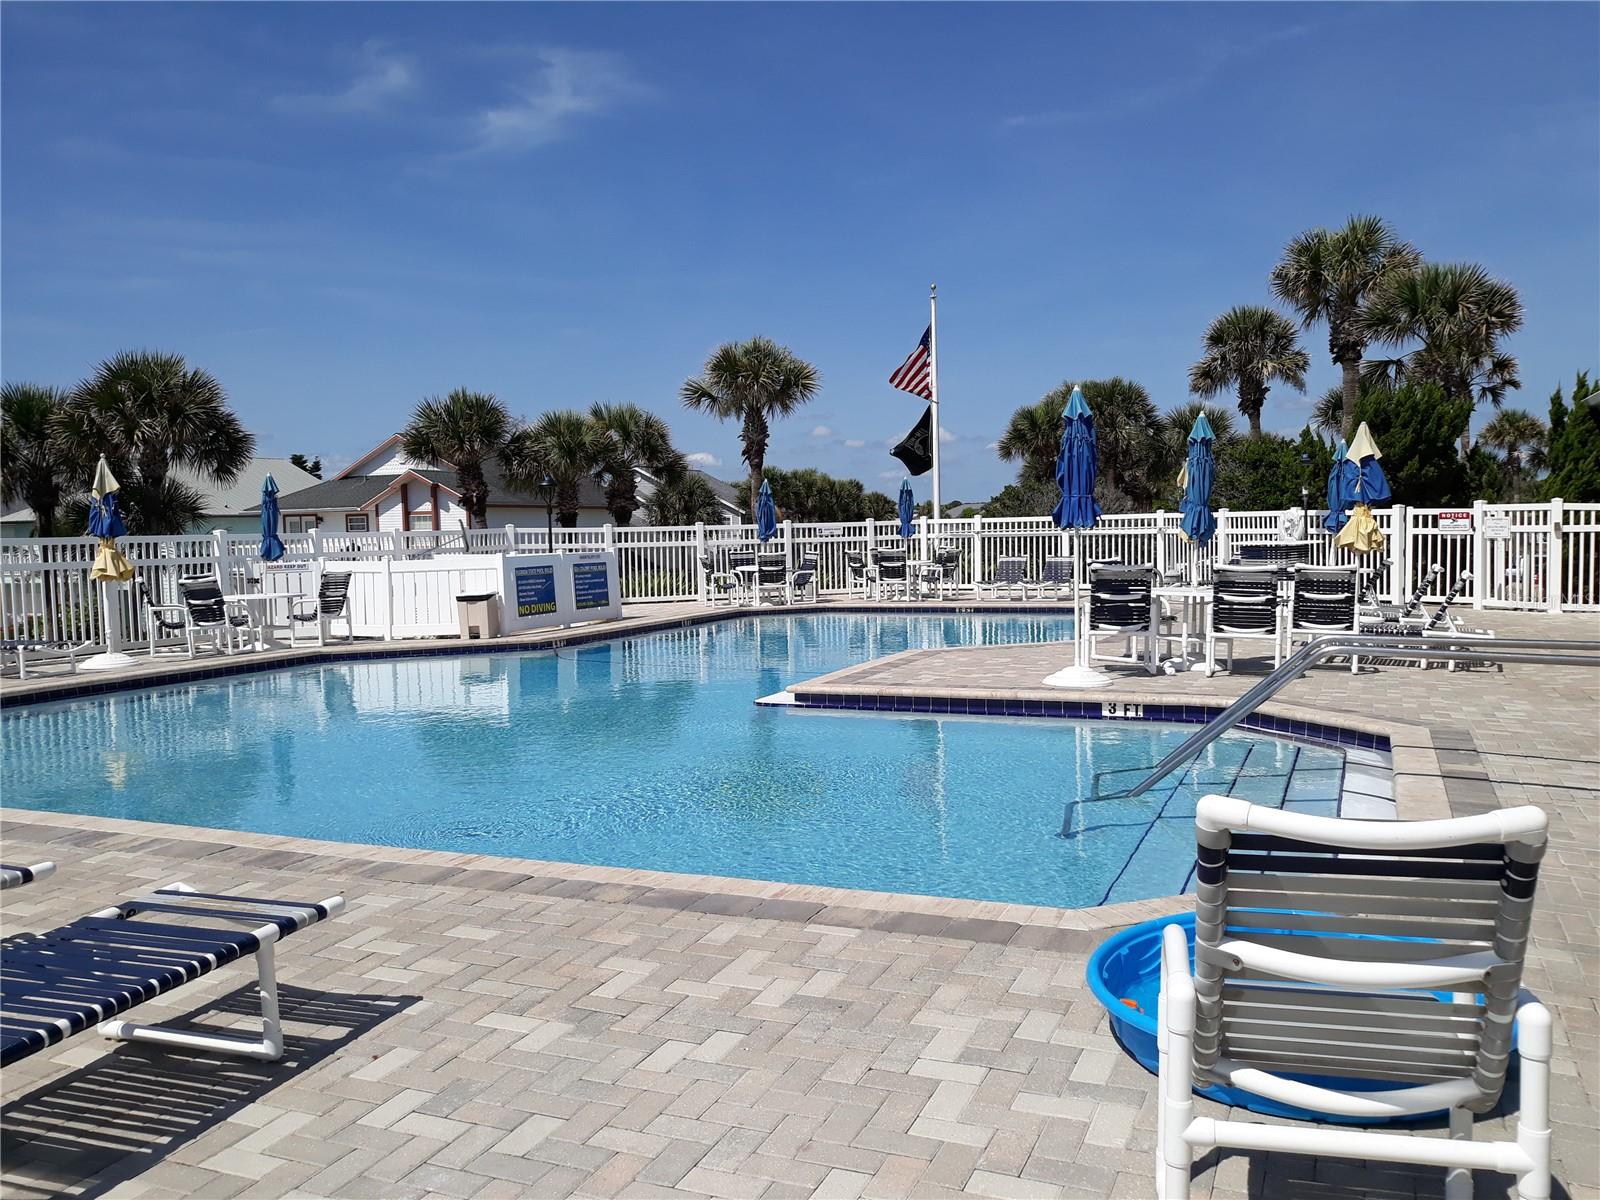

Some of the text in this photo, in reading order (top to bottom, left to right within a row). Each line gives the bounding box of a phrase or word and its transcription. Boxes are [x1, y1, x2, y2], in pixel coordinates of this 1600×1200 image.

[519, 602, 556, 615] NO DIVING
[1108, 702, 1117, 714] 3
